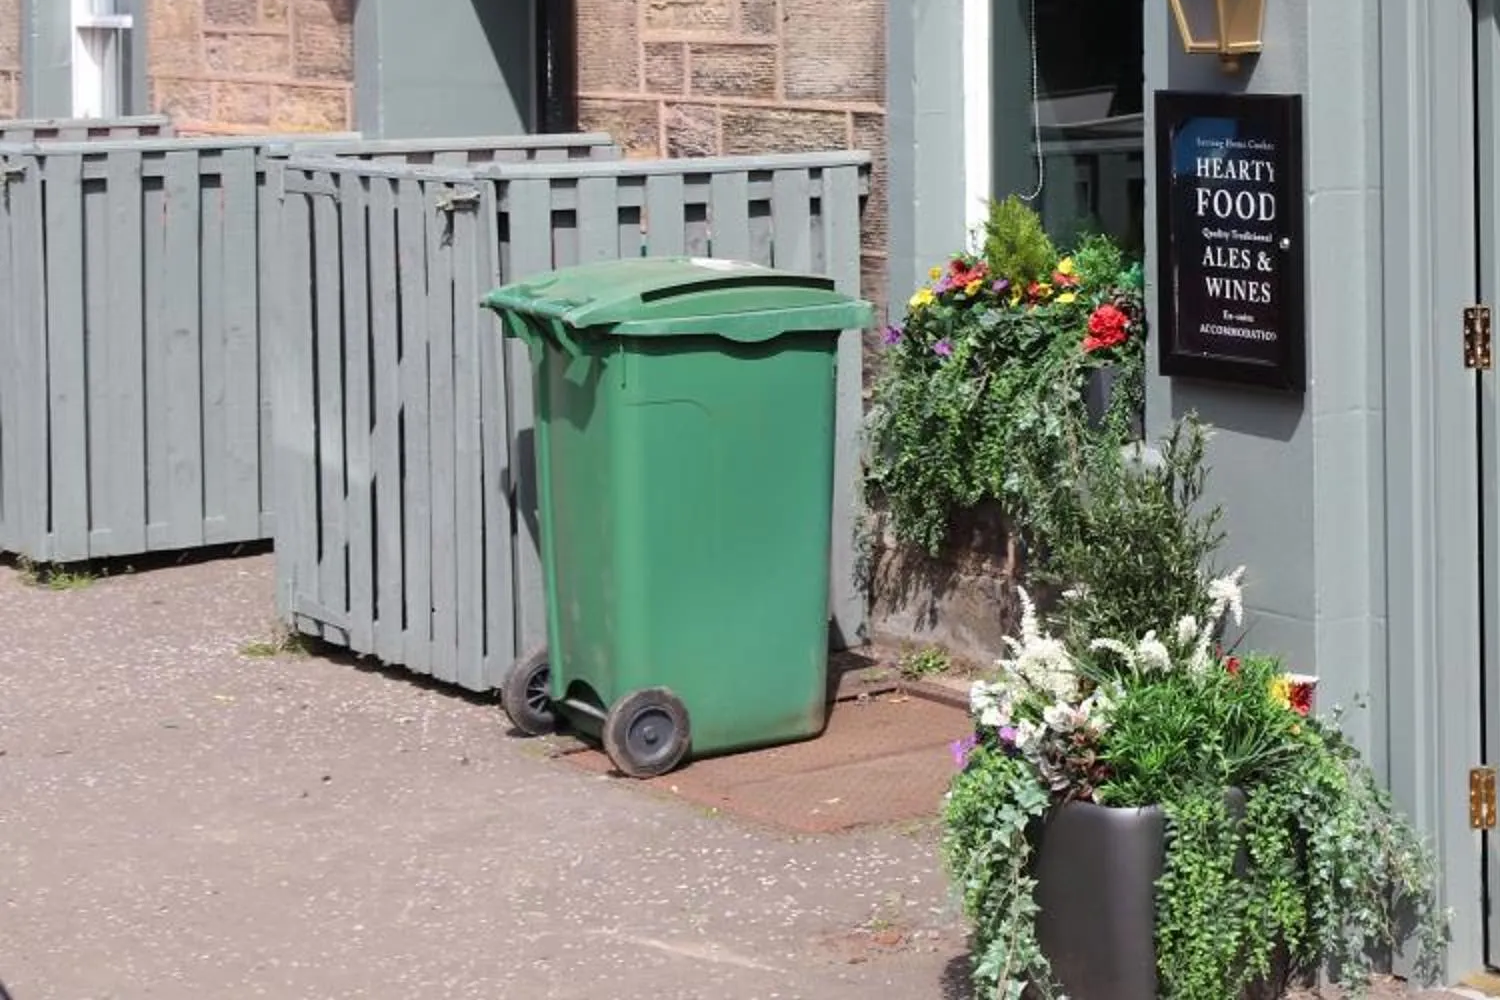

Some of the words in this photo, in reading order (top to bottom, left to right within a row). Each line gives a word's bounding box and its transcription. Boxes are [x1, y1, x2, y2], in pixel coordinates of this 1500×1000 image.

[1196, 157, 1275, 182] HEARTY
[1196, 187, 1275, 221] FOOD
[1202, 245, 1251, 270] ALES
[1257, 251, 1272, 272] &
[1205, 276, 1271, 303] WINES
